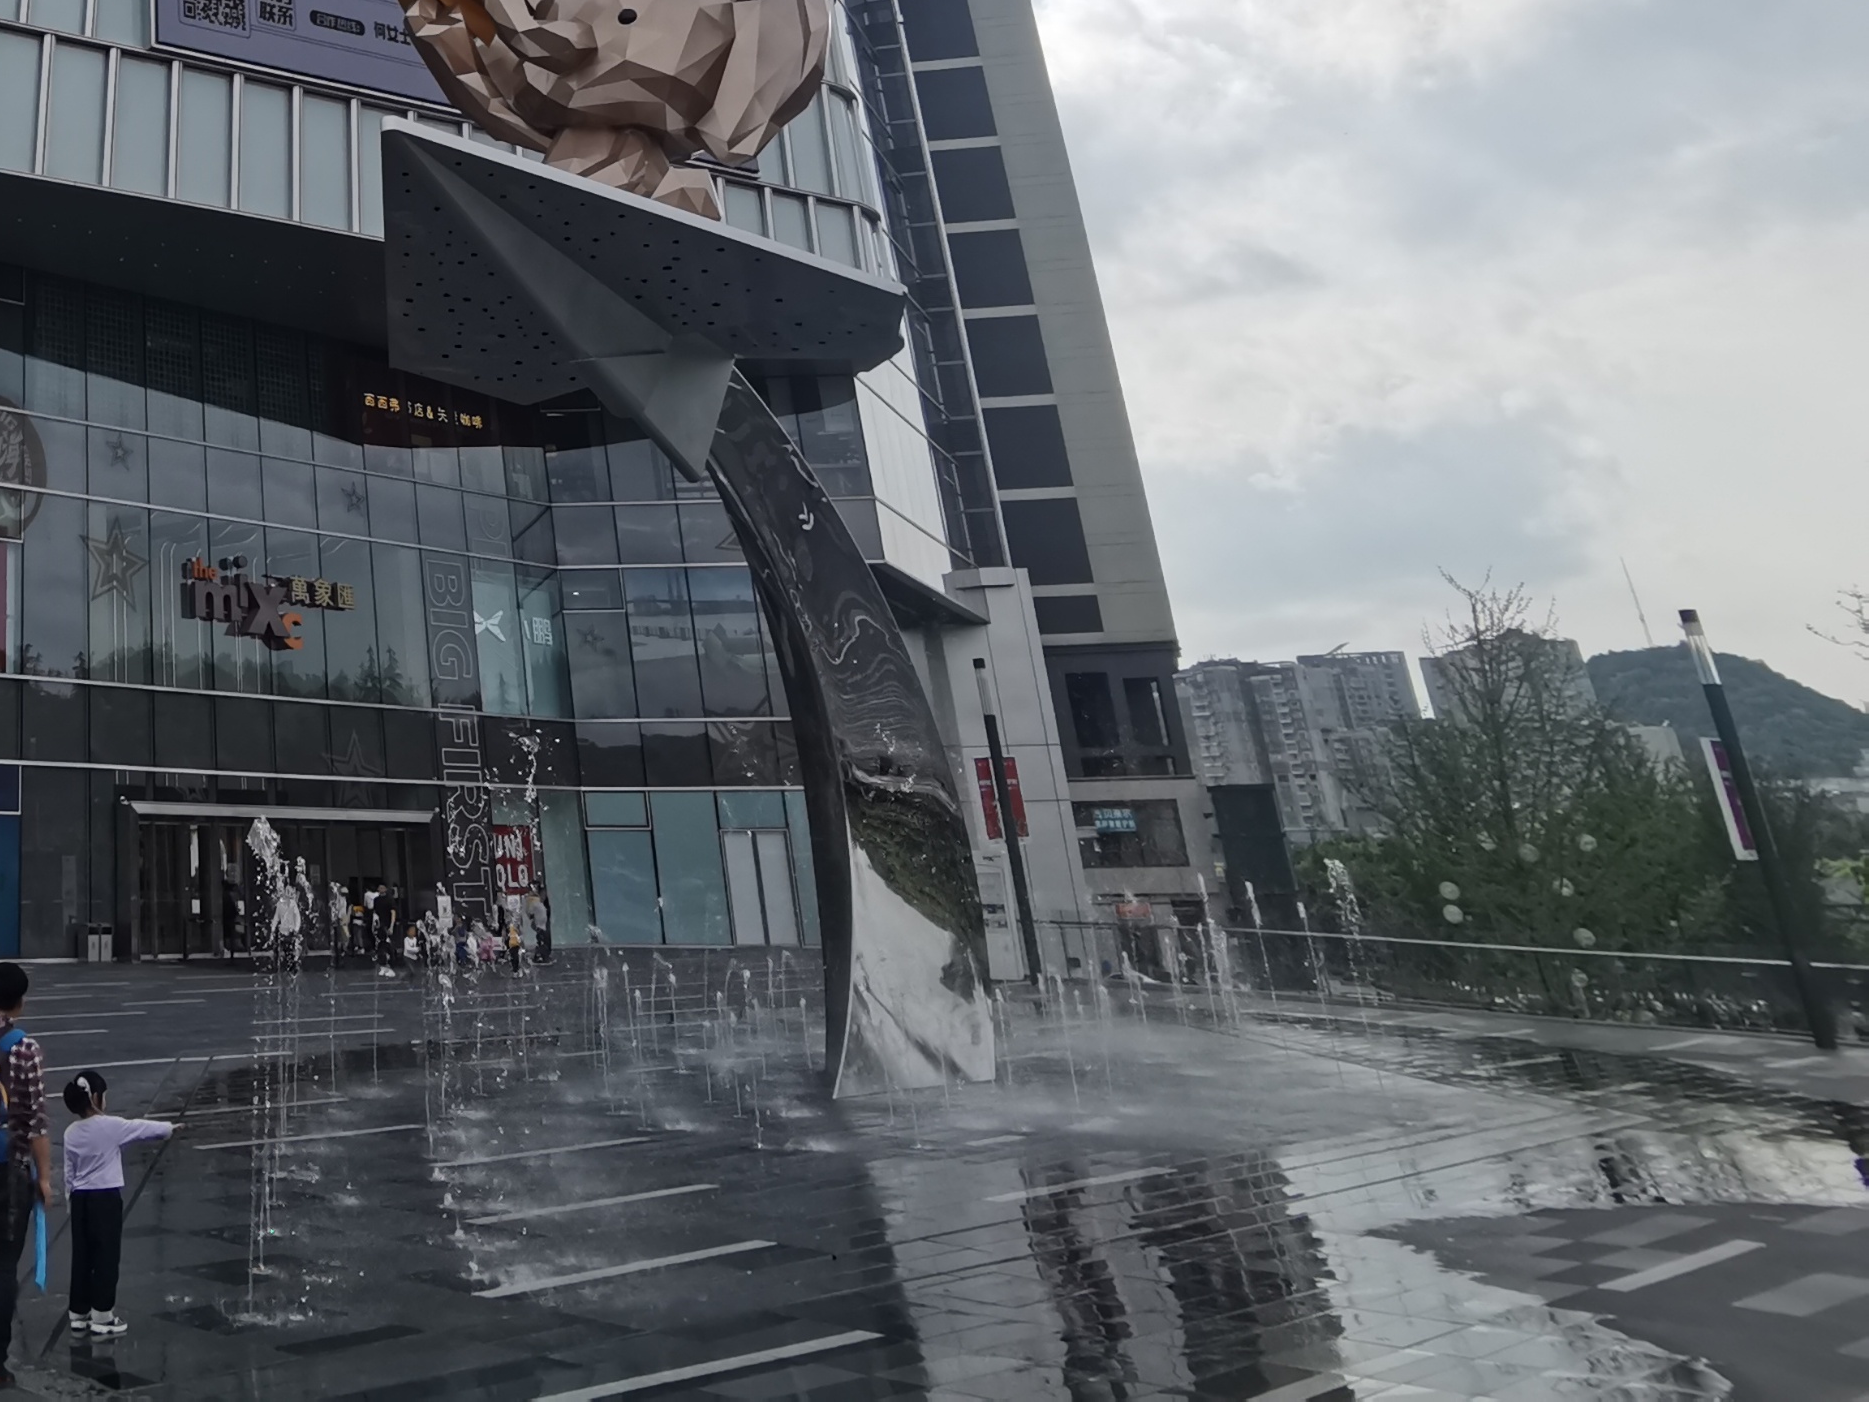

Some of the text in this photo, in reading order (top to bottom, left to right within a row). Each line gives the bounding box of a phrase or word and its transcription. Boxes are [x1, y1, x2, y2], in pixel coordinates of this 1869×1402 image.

[192, 556, 218, 580] the
[290, 575, 355, 610] 萬象匯
[426, 559, 473, 680] BIG
